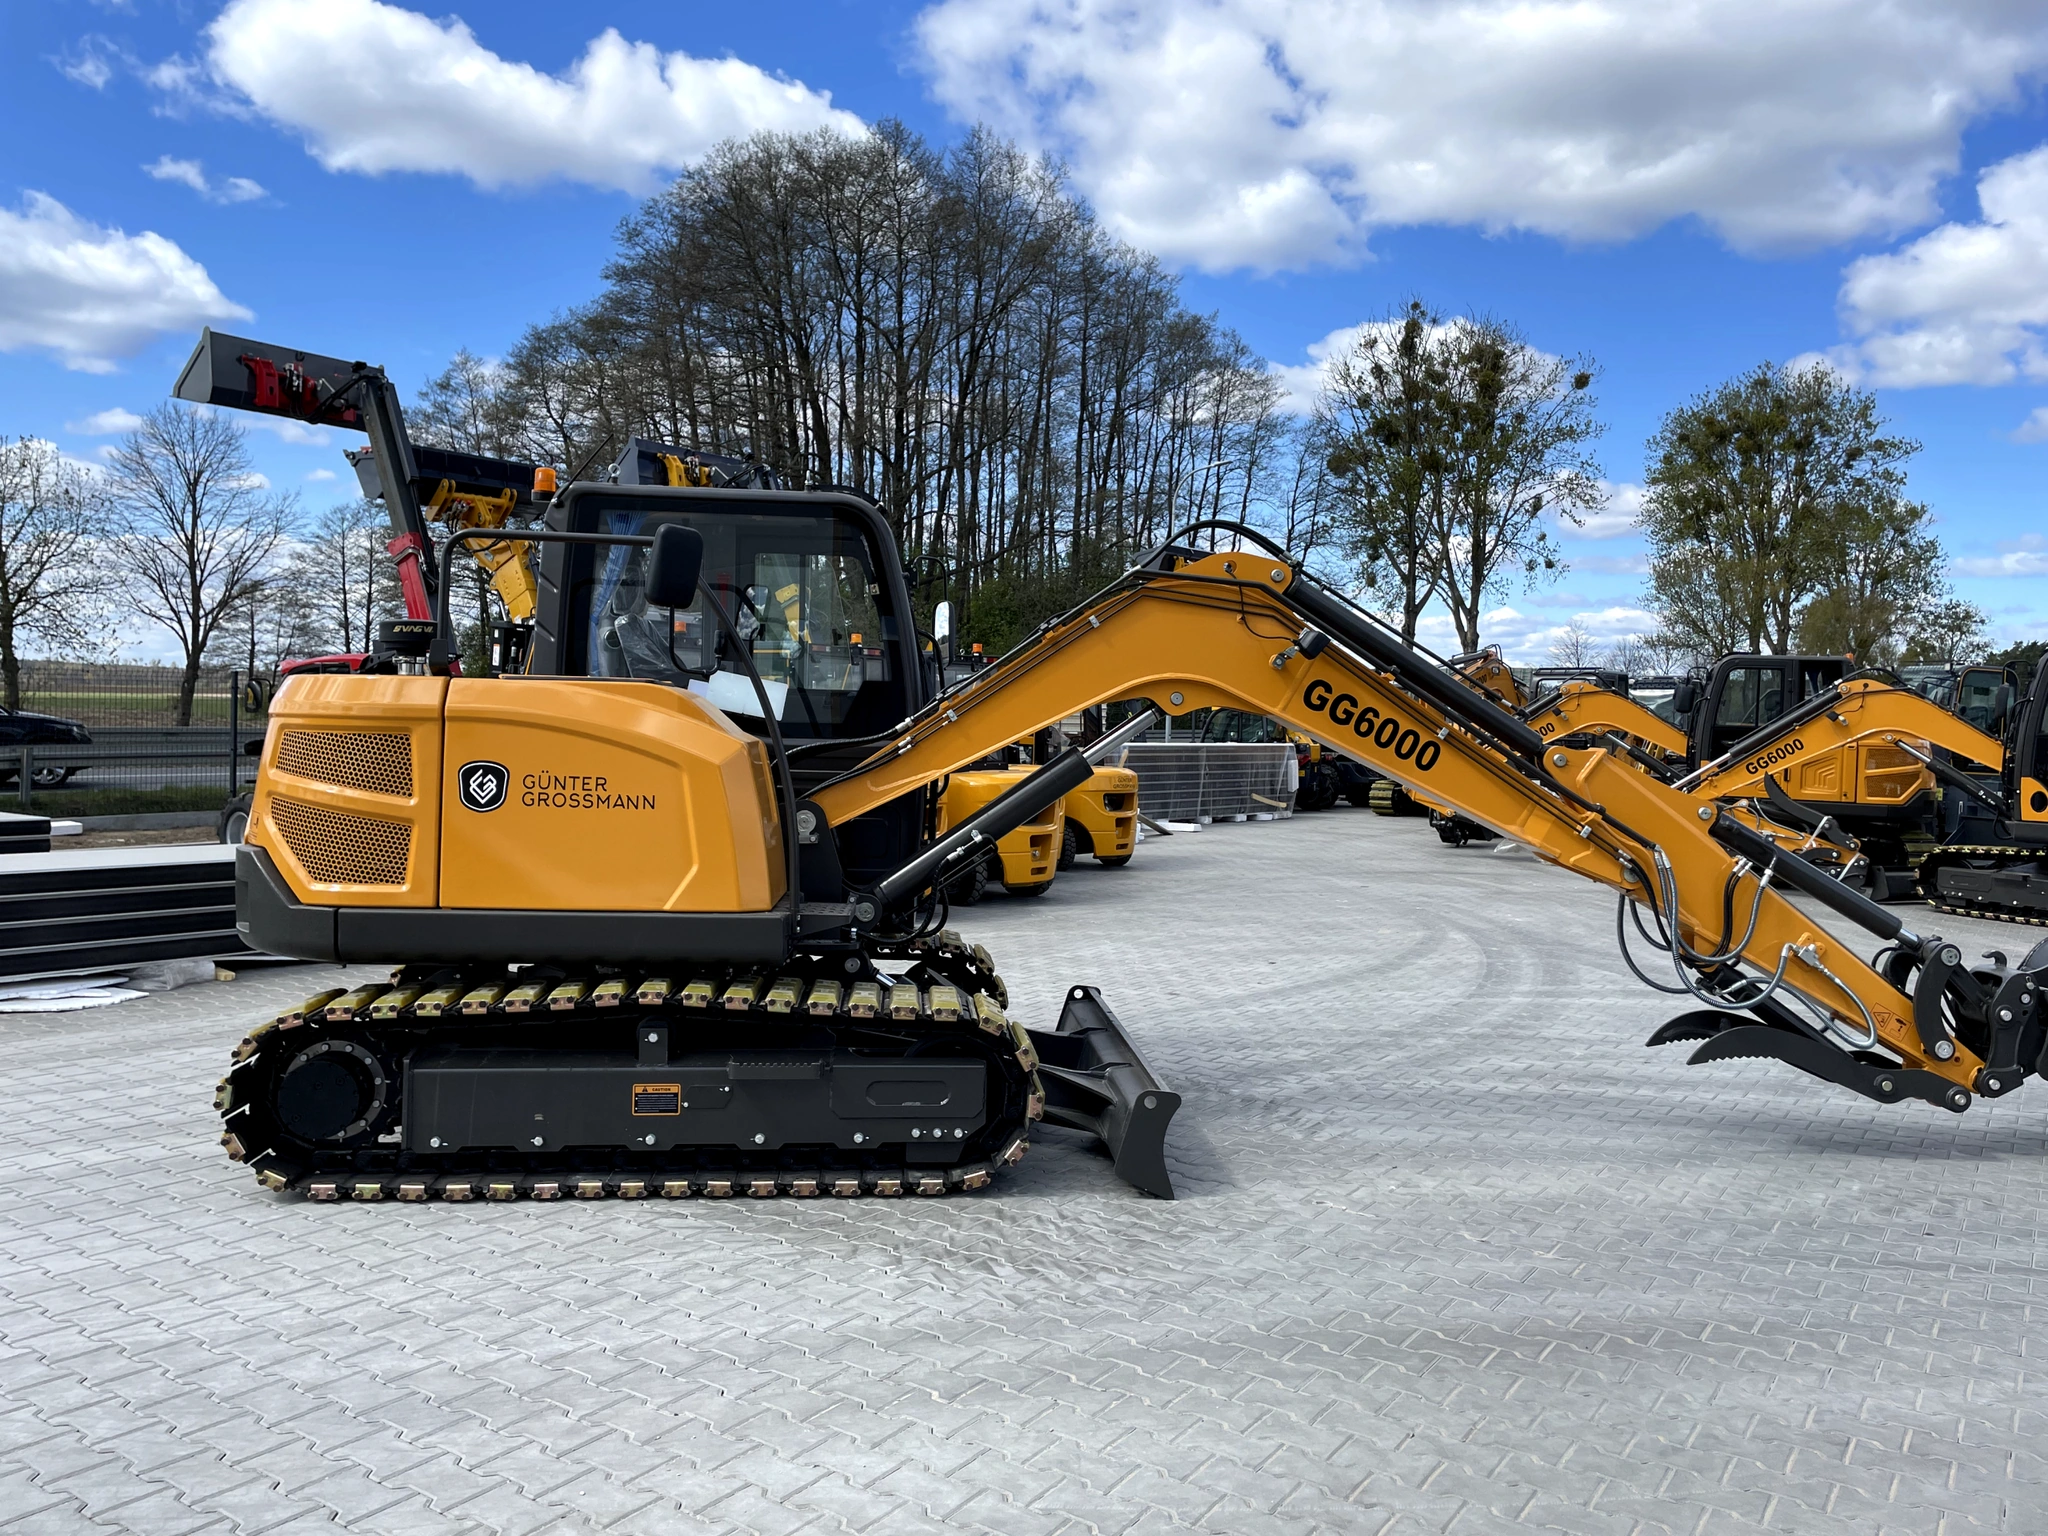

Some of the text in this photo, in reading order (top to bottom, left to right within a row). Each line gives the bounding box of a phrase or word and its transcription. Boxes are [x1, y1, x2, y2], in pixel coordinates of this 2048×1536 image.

[1303, 679, 1441, 772] GG6000
[1745, 738, 1804, 775] GG6000
[522, 770, 608, 792] GÜNTER
[521, 791, 656, 810] GROSSMANN
